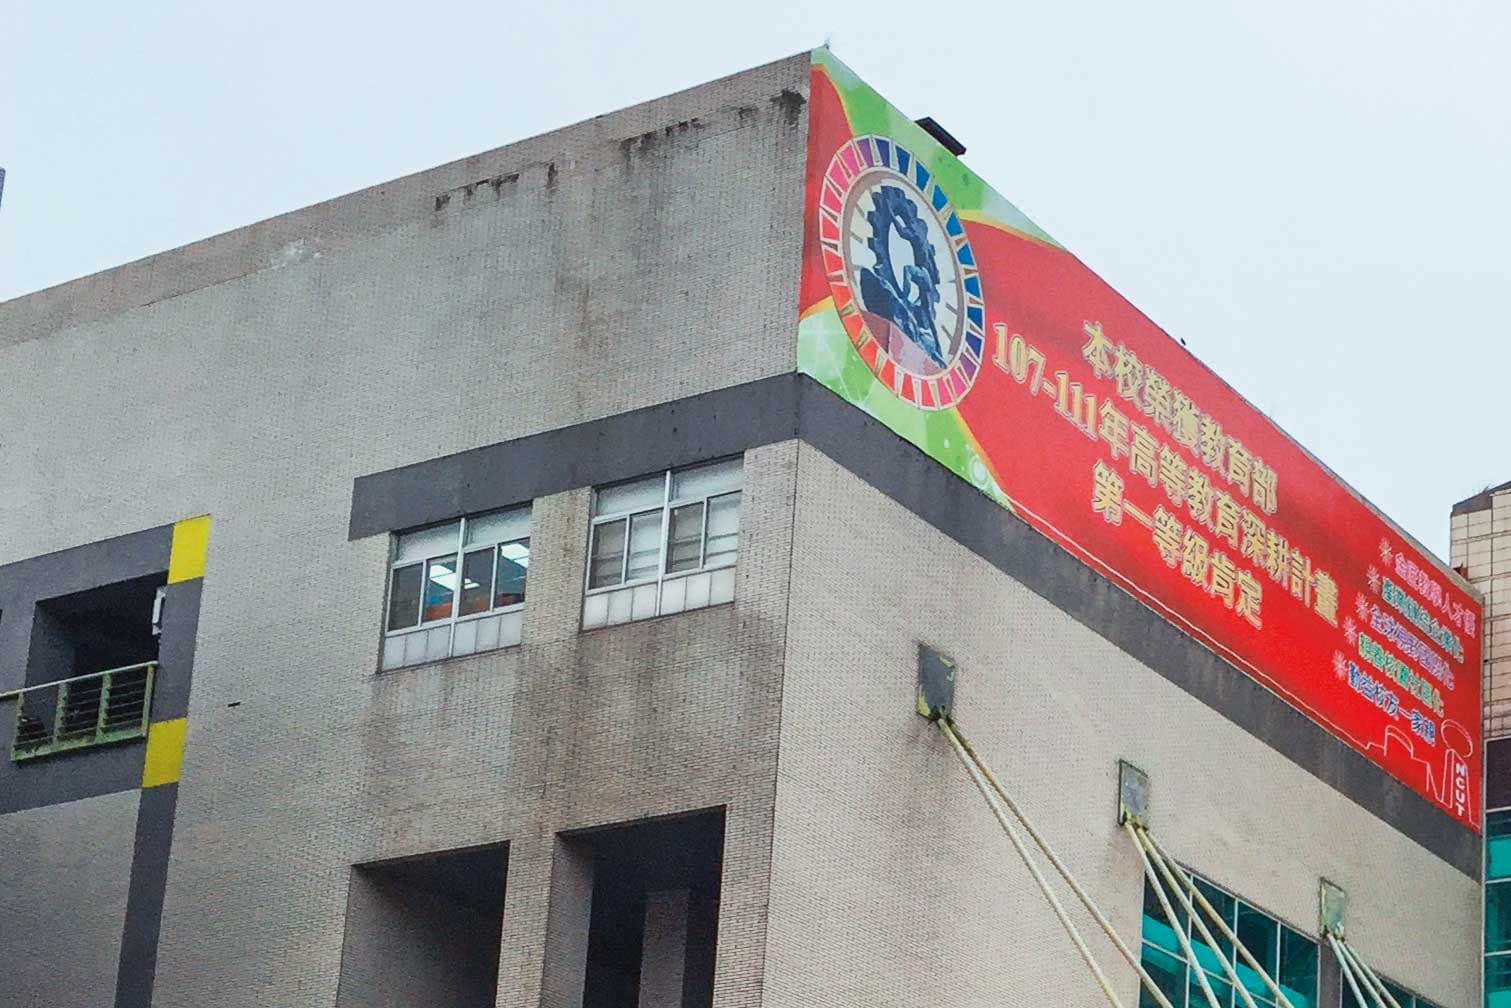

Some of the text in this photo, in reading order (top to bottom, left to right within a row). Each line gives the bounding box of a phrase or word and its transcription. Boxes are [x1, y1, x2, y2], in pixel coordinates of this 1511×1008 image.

[1082, 320, 1278, 515] 本校榮獲教育部
[1091, 459, 1263, 631] 第一等級肯定
[1454, 761, 1468, 818] NCUT
